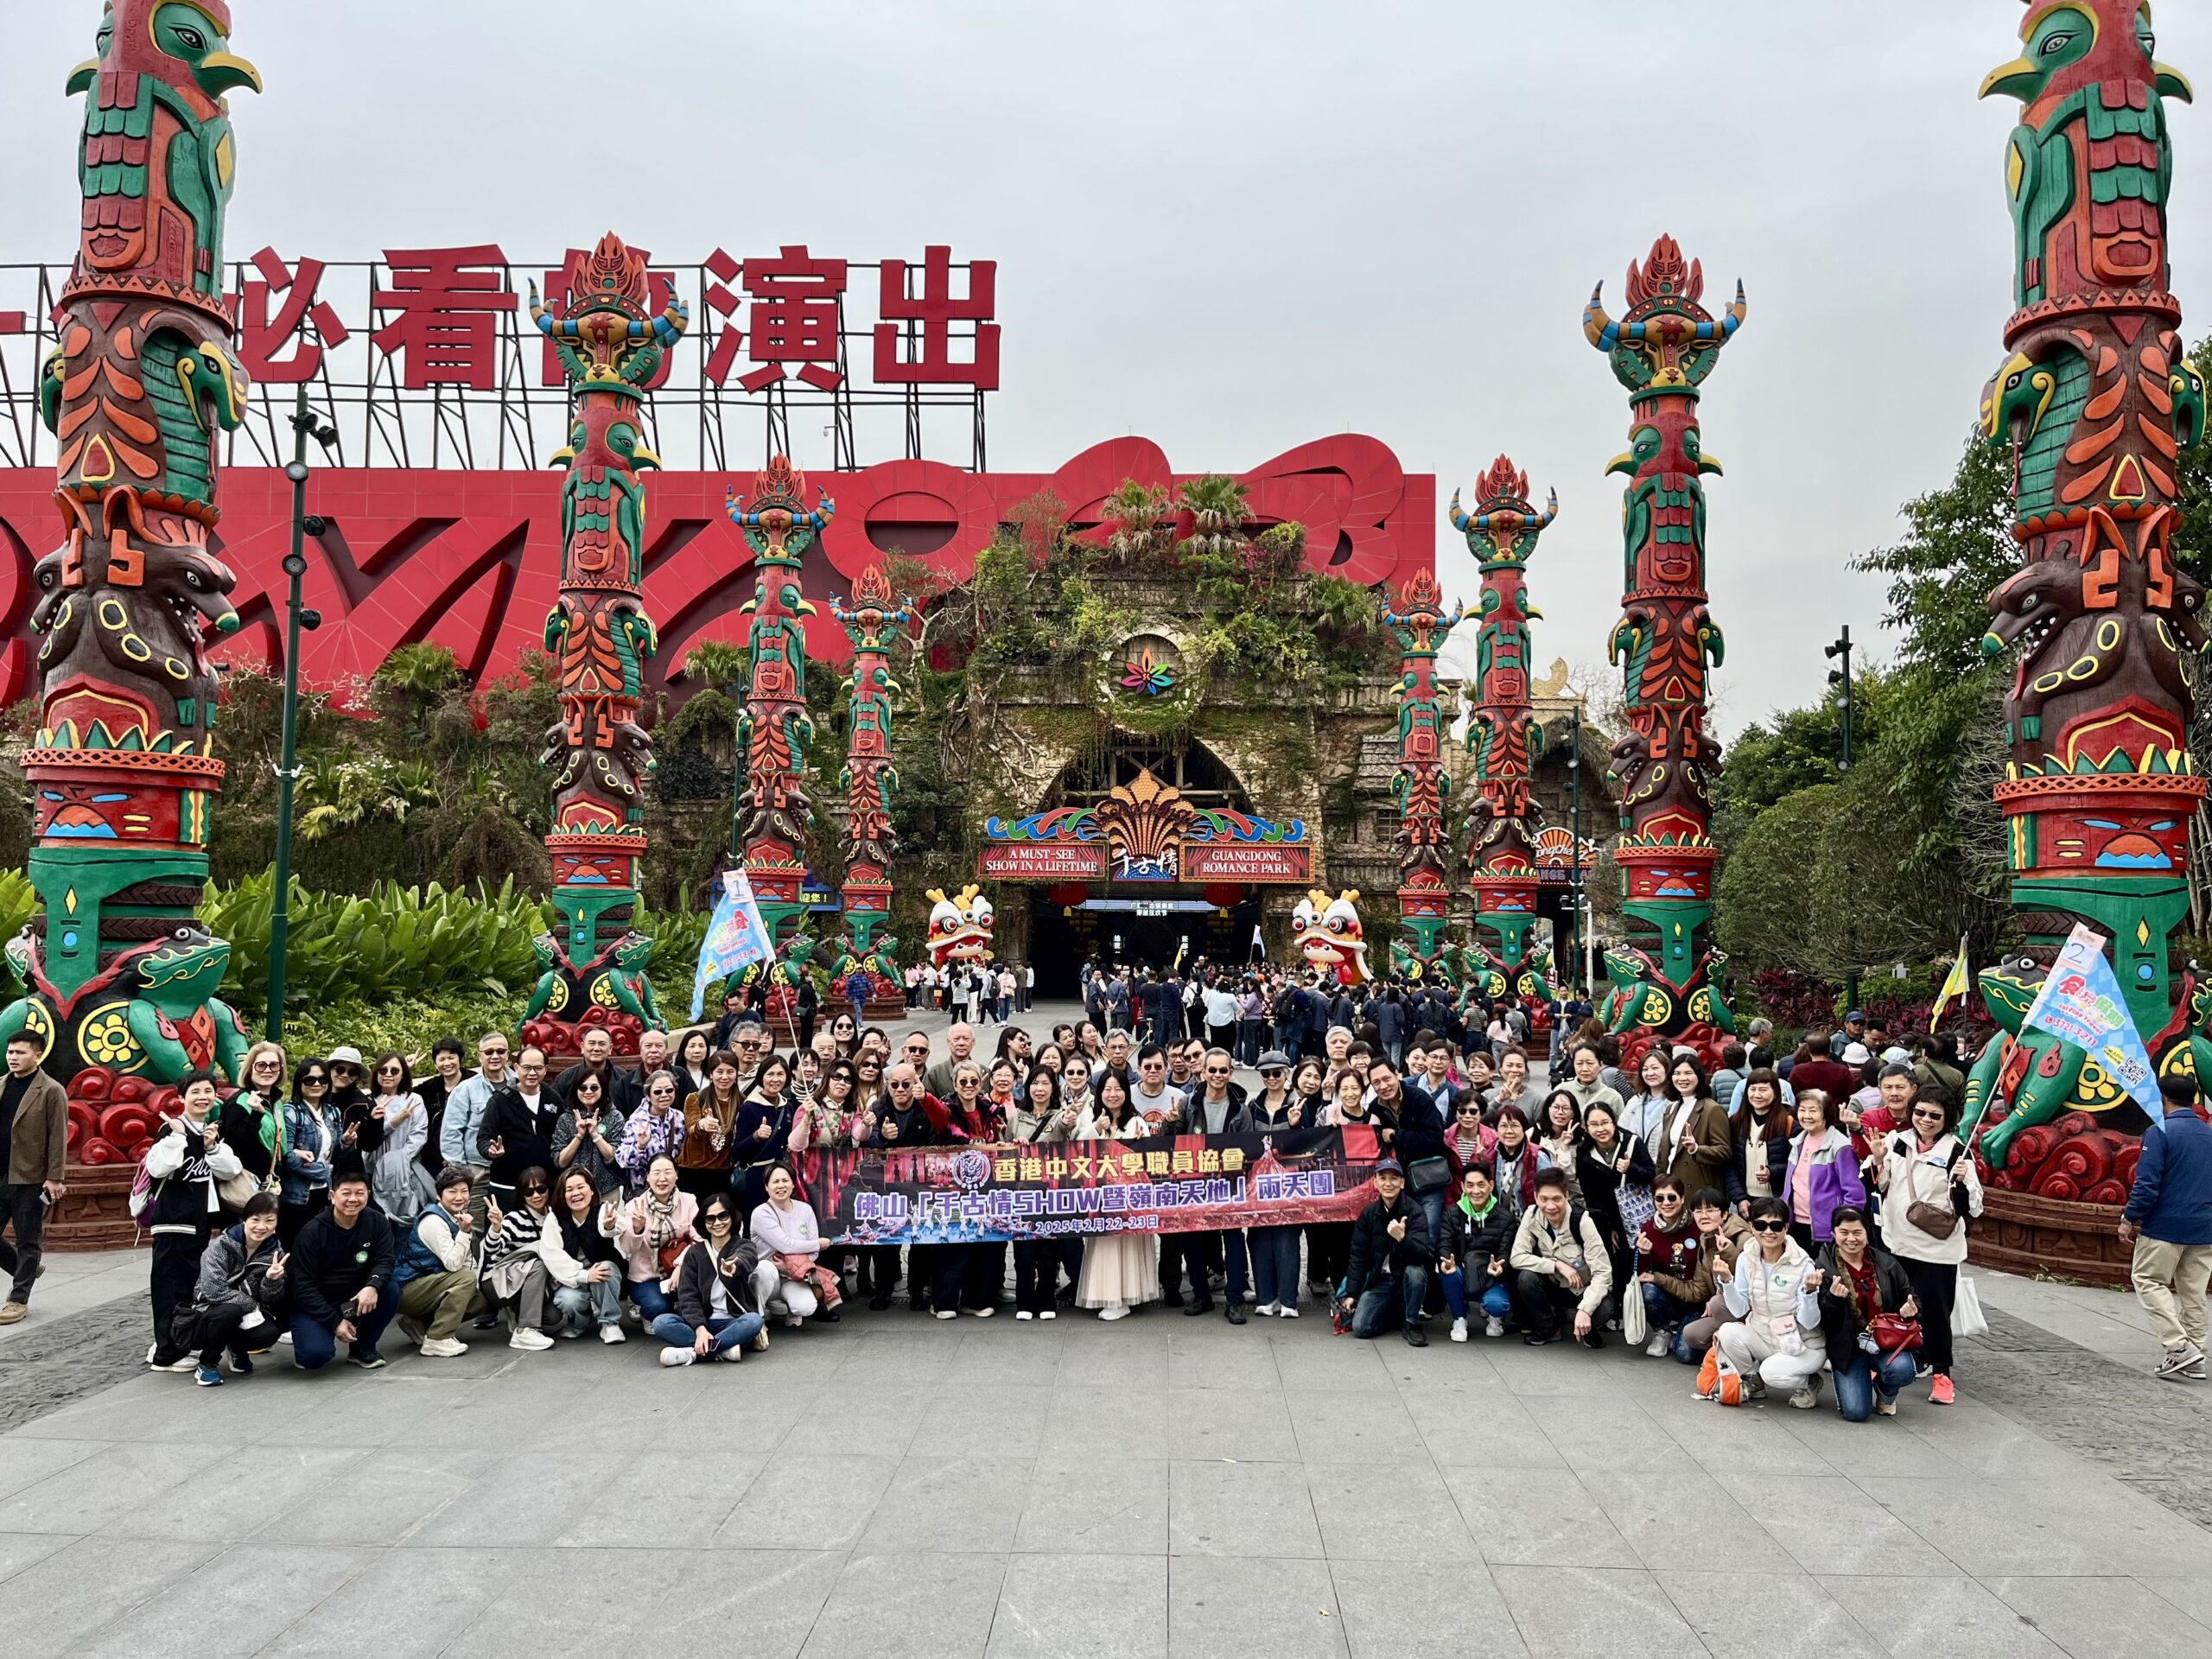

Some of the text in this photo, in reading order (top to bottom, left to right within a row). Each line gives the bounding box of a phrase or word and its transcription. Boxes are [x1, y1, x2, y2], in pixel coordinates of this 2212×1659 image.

[1009, 849, 1075, 860] A MUST-SEE
[1109, 847, 1179, 878] 千古情
[1211, 850, 1282, 861] GUANGDONG
[986, 860, 1097, 872] SHOW IN A LIFETIME
[1203, 862, 1291, 874] ROMANCE PARK
[2069, 943, 2085, 965] 2
[2053, 1018, 2097, 1046] 3721 3211
[994, 1147, 1245, 1182] 香港中文大學職員協會
[1035, 1215, 1159, 1234] 2025年2月22-23日
